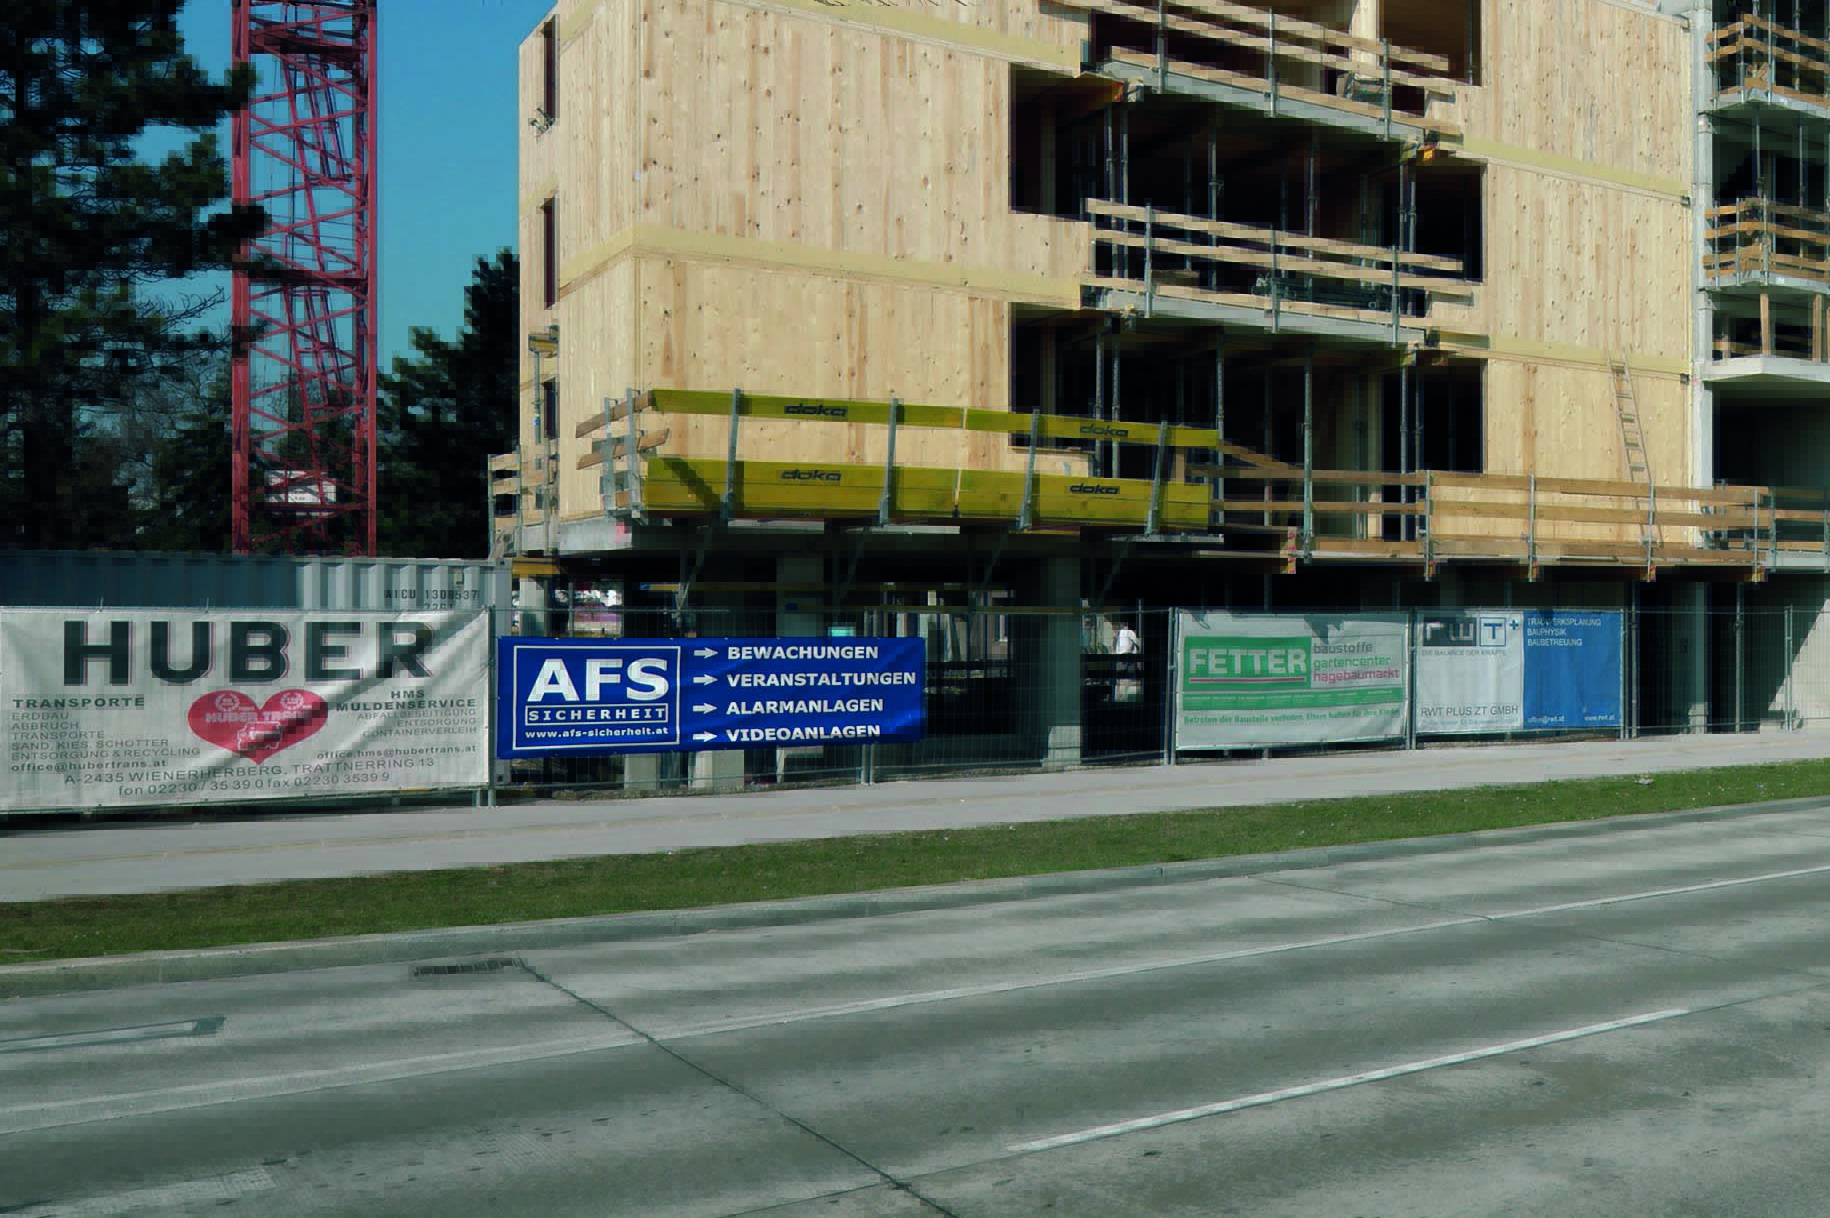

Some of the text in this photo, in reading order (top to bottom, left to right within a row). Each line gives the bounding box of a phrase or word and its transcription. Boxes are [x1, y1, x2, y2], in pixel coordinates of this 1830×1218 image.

[784, 403, 847, 417] doka
[1080, 424, 1128, 437] doka
[781, 468, 842, 481] doka
[1071, 483, 1120, 495] doka
[63, 620, 436, 686] HUBER
[728, 646, 879, 660] BEWACHUNGEN
[1313, 642, 1373, 654] baustoffe
[1189, 648, 1307, 674] FETTER
[1313, 655, 1392, 670] gartencenter
[527, 658, 670, 702] AFS
[727, 671, 916, 687] VERANSTALTUNGEN
[1312, 668, 1400, 684] hagebaumarkt
[391, 689, 425, 699] HMS
[13, 697, 145, 708] TRANSPORTE
[336, 698, 476, 712] MULDENSERVICE
[726, 699, 884, 715] ALARMANLAGEN
[12, 712, 70, 721] ERDBAU
[528, 708, 666, 721] SICHERHEIT
[1421, 705, 1518, 717] RWT PLUS ZT GMBH
[12, 722, 79, 731] ABBRUCH
[397, 718, 477, 728] ENTSORGUNG
[12, 731, 105, 741] TRANSPORTE
[525, 727, 669, 739] www.afs-sicherheit.at
[726, 724, 881, 742] VIDEOANLAGEN
[96, 739, 168, 749] SCHOTTER
[12, 747, 201, 761] ENTSORGUNG & RECYCLING
[293, 758, 415, 775] TRATTNERRING
[419, 757, 434, 768] 13
[118, 785, 143, 797] fon
[148, 782, 197, 795] 02230
[267, 779, 290, 790] fax
[294, 774, 339, 787] 02230
